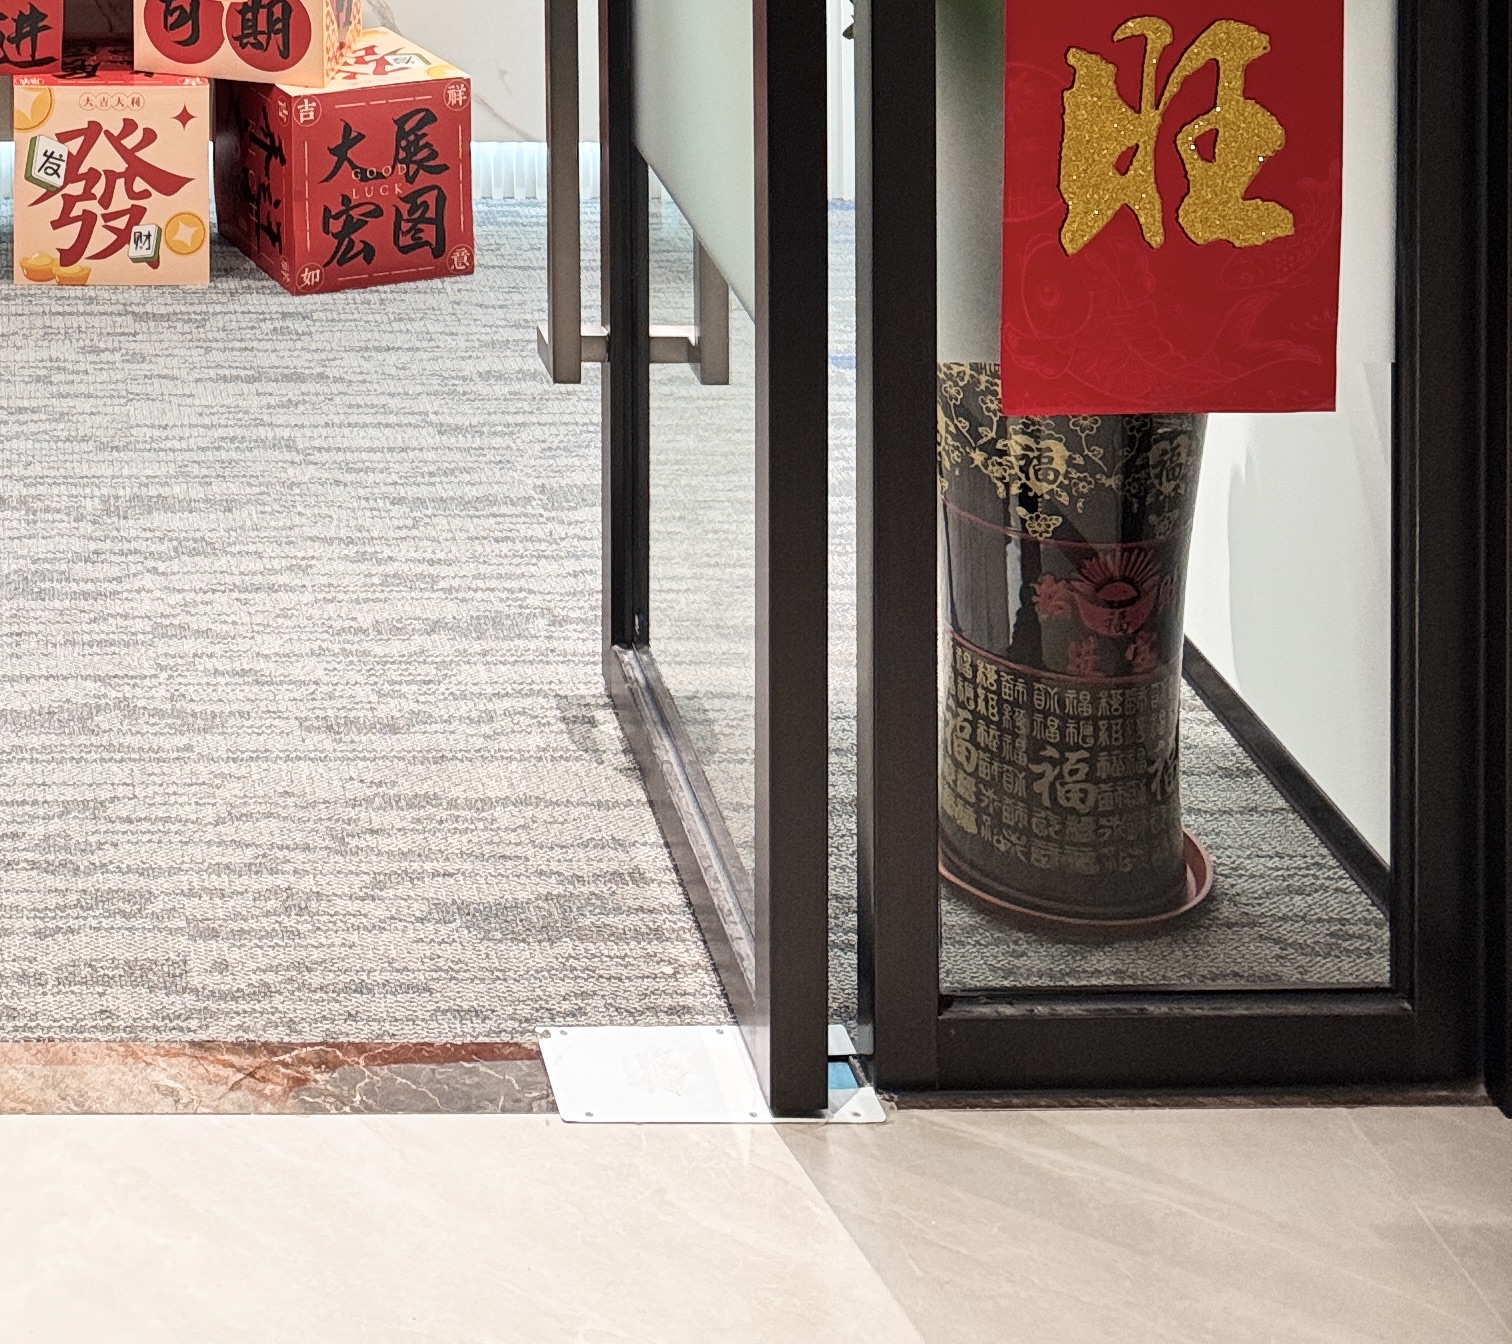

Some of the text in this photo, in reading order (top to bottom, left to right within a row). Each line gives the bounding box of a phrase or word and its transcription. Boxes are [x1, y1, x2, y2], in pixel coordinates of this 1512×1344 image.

[37, 148, 66, 179] 发
[351, 164, 408, 180] GOOD
[28, 118, 196, 270] 發
[352, 182, 404, 200] LUCK
[1029, 745, 1099, 813] 福
